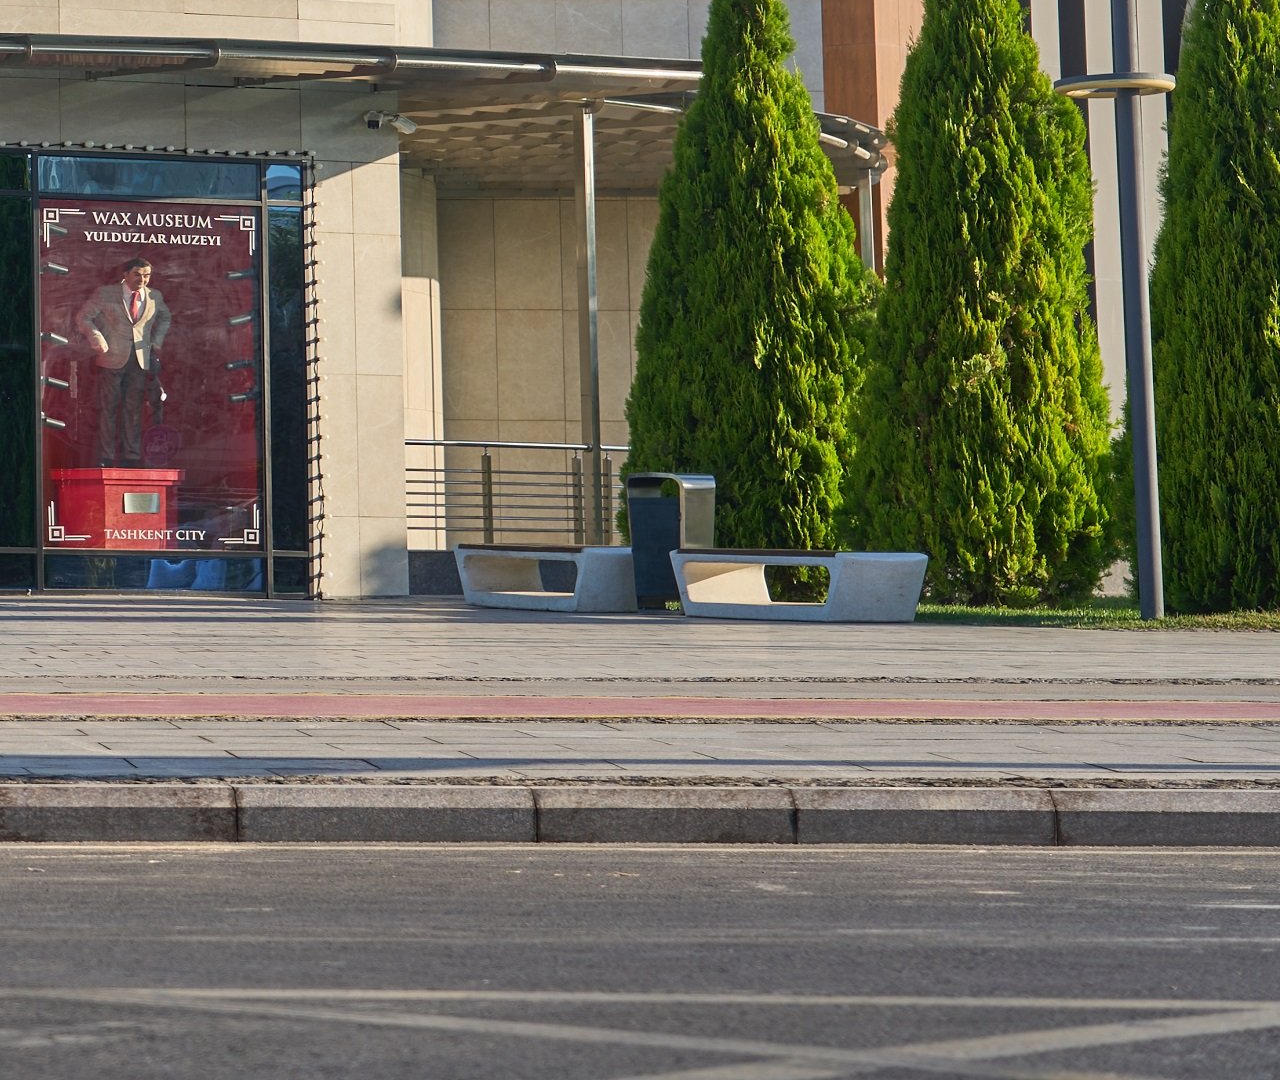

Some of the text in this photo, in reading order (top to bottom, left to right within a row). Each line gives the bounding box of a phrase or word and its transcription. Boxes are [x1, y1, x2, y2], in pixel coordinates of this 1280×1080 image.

[92, 211, 213, 229] WAX MUSEUM
[84, 231, 222, 246] YULDUZLAR MUZEYI
[104, 529, 207, 541] TASHKENT CITY
